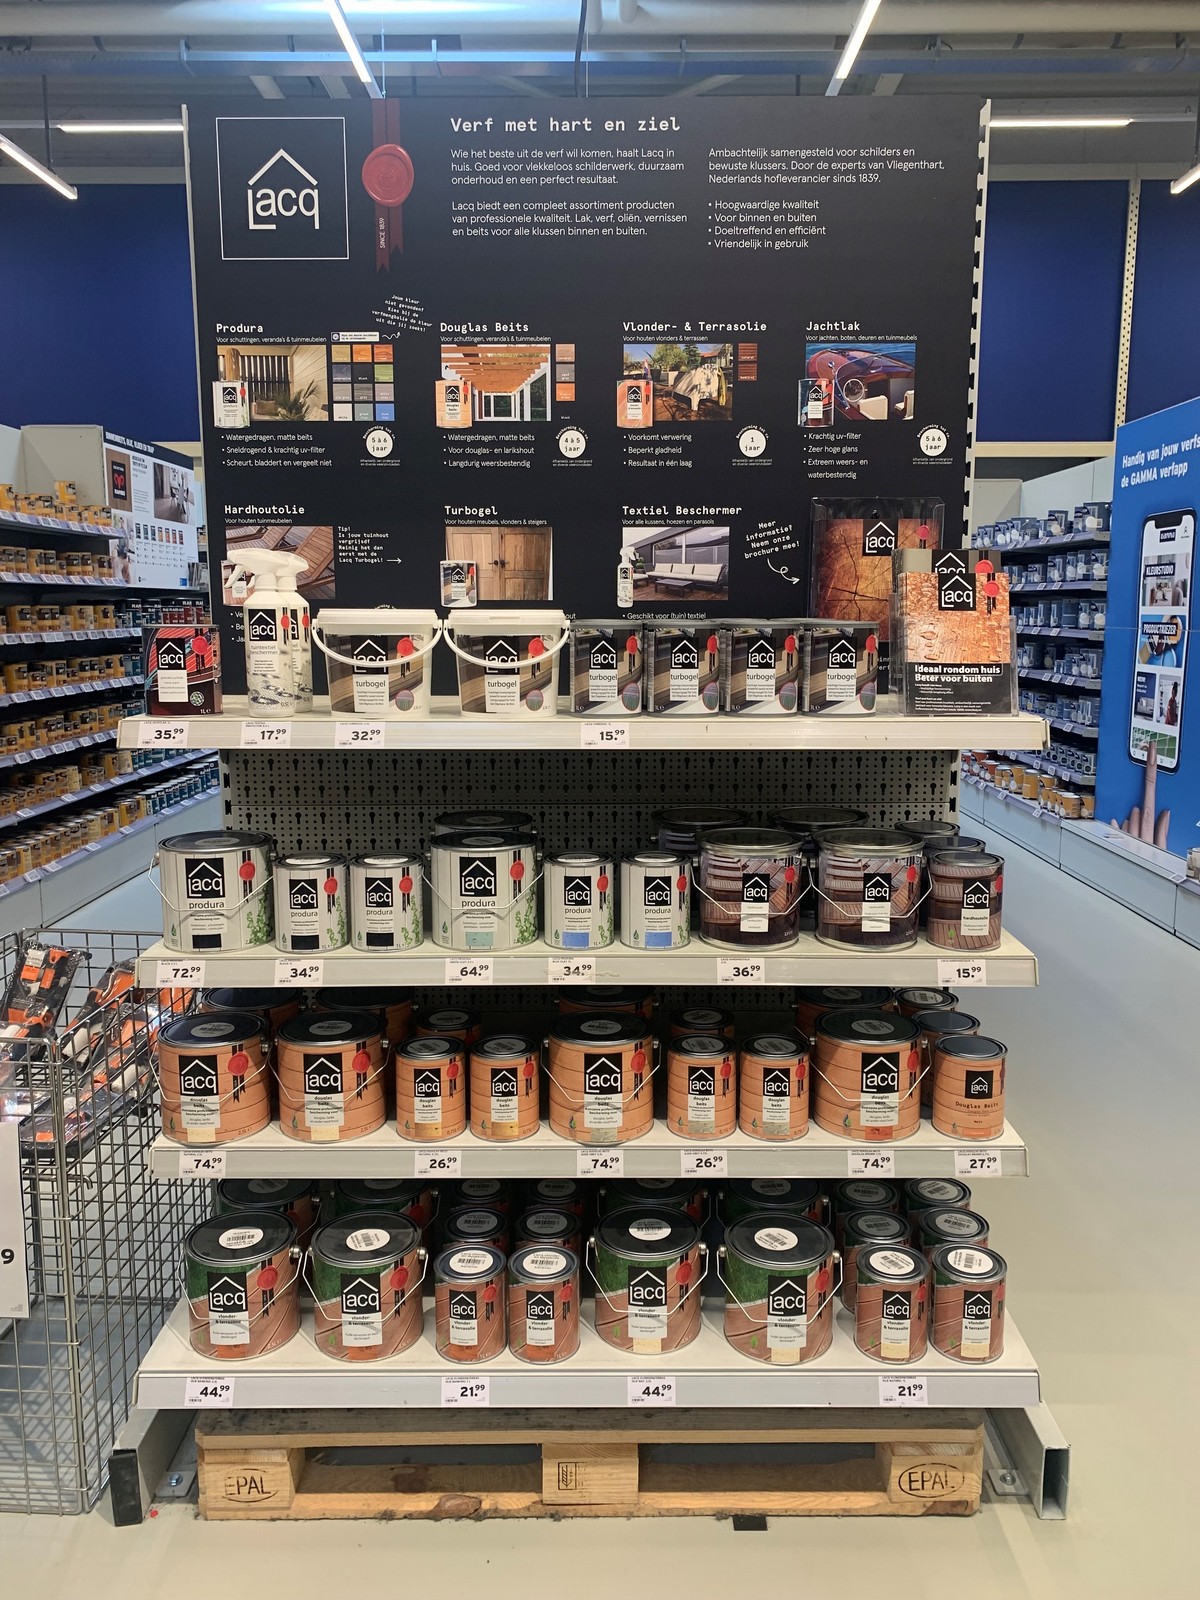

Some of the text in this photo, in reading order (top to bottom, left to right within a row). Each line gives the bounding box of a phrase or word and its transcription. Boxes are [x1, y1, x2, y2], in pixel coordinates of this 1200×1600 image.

[451, 116, 680, 132] Verf met hart en ziel
[451, 148, 674, 159] Wie het beste uit de verf wil komen, haalt Lacq in
[709, 148, 768, 159] Ambachtelijk
[771, 148, 834, 159] samengesteld
[860, 147, 900, 156] schilders
[452, 162, 472, 171] huis.
[475, 162, 500, 171] Goed
[526, 162, 573, 171] vlekkeloos
[576, 162, 636, 171] schilderwerk,
[638, 162, 684, 170] duurzaam
[709, 160, 944, 172] bewuste klussers. Door de experts van Vliegenthart,
[452, 176, 503, 184] onderhoud
[540, 175, 574, 186] perfect
[577, 175, 618, 184] resultaat.
[709, 174, 880, 183] Nederlands hofleverancier sinds 1839.
[248, 189, 319, 229] Lacq
[715, 200, 819, 211] Hoogwaardige kwaliteit
[715, 213, 737, 222] Voor
[740, 213, 770, 222] binnen
[788, 213, 816, 222] buiten
[715, 226, 772, 235] Doeltreffend
[789, 226, 826, 234] efficiënt
[714, 239, 808, 250] Vriendelijk in gebruik
[216, 324, 263, 332] Produra
[440, 322, 528, 334] Douglas Beits
[623, 322, 766, 331] Vlonder- & Terrasolie
[806, 321, 860, 330] Jachtlak
[226, 434, 276, 442] Watergedragen,
[661, 434, 692, 442] verwering
[809, 433, 835, 441] Krachtig
[465, 447, 492, 456] douglas-
[628, 447, 682, 455] Beperkt gladheid
[825, 446, 840, 454] hoge
[842, 446, 858, 454] glans
[1122, 450, 1145, 469] Handig
[1147, 448, 1160, 462] van
[1160, 444, 1179, 461] jouw
[680, 460, 692, 468] laag
[1121, 461, 1189, 488] de GAMMA verfapp
[225, 505, 304, 514] Hardhoutolie
[445, 506, 498, 517] Turbogel
[622, 506, 742, 515] Textiel Beschermer
[758, 520, 776, 530] Meer
[751, 534, 791, 549] Neem onze
[744, 541, 800, 560] brochure mee!
[1146, 564, 1174, 577] KLEURSTUDIO
[942, 591, 973, 608] Lacq
[1144, 622, 1177, 635] PRODUCTKIEZER
[159, 650, 184, 668] Lacq
[915, 665, 1001, 674] Ideaal rondom huis
[590, 674, 618, 682] turbogel
[915, 674, 939, 682] Beter
[962, 675, 993, 683] buiten
[356, 680, 386, 688] turbogel
[488, 681, 516, 689] turbogel
[154, 728, 184, 739] 35.99
[261, 729, 286, 740] 17.99
[352, 730, 380, 740] 32.99
[600, 730, 625, 740] 15.99
[186, 874, 224, 898] Lacq
[462, 873, 497, 894] Lacq
[462, 899, 496, 908] produra
[291, 910, 318, 918] produra
[172, 967, 200, 978] 72.99
[290, 966, 319, 978] 34.99
[460, 965, 489, 976] 64.99
[564, 965, 592, 976] 34.99
[733, 966, 760, 977] 36.99
[956, 967, 981, 978] 15.99
[181, 1072, 216, 1094] Lacq
[956, 1101, 981, 1109] Douglas
[194, 1158, 222, 1169] 74.99
[430, 1157, 457, 1168] 26.99
[592, 1157, 619, 1168] 74.99
[696, 1156, 723, 1168] 26.99
[862, 1157, 890, 1168] 74.99
[970, 1157, 997, 1168] 27.99
[628, 1284, 667, 1307] Lacq
[200, 1385, 230, 1397] 44.99
[460, 1385, 485, 1397] 21.99
[642, 1385, 672, 1396] 44.99
[898, 1384, 923, 1396] 21.99
[225, 1476, 271, 1496] EPAL
[908, 1470, 955, 1492] EPAL
